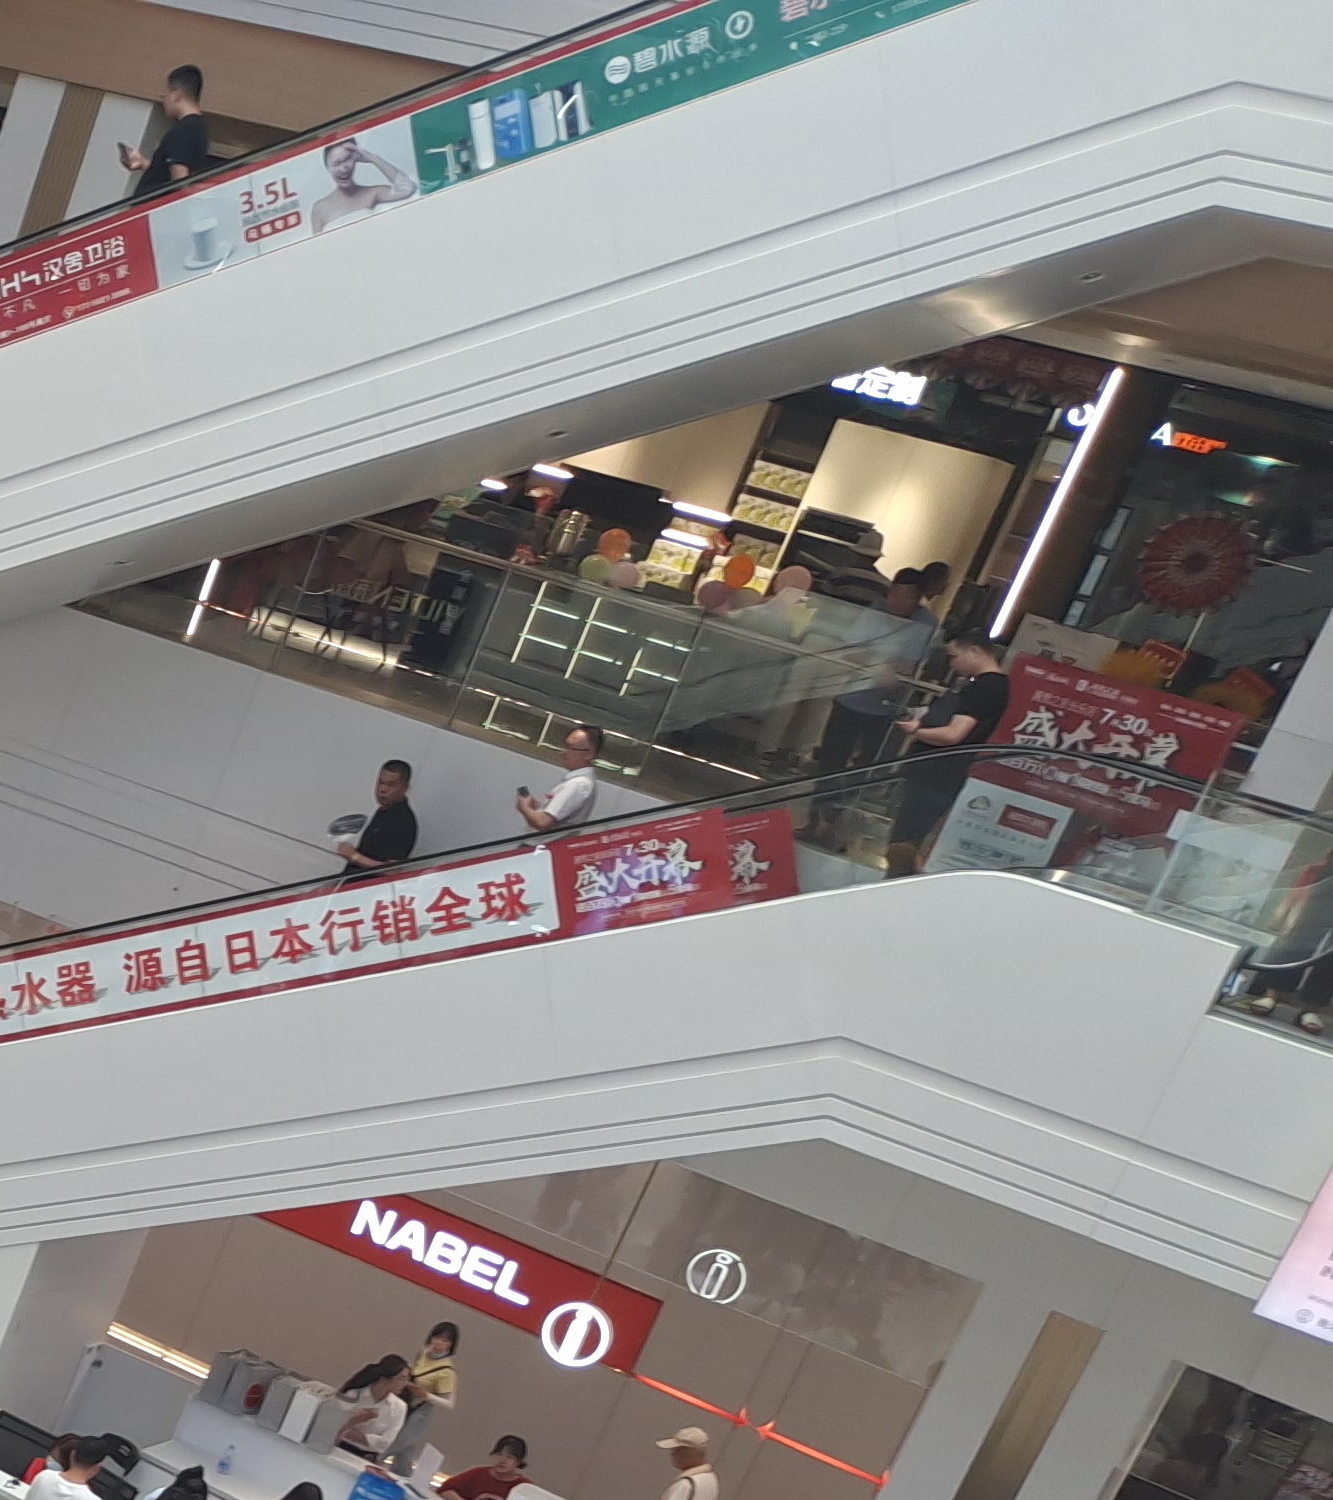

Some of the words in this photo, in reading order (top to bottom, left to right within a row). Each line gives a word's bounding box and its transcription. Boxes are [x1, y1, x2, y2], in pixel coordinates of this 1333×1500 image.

[632, 27, 717, 73] 碧水源
[239, 177, 298, 215] 3.5L
[43, 235, 125, 281] 汉舍卫浴
[574, 838, 704, 901] 盛大开幕
[123, 873, 531, 995] 源自日本行销全球
[350, 1200, 531, 1307] NABEL
